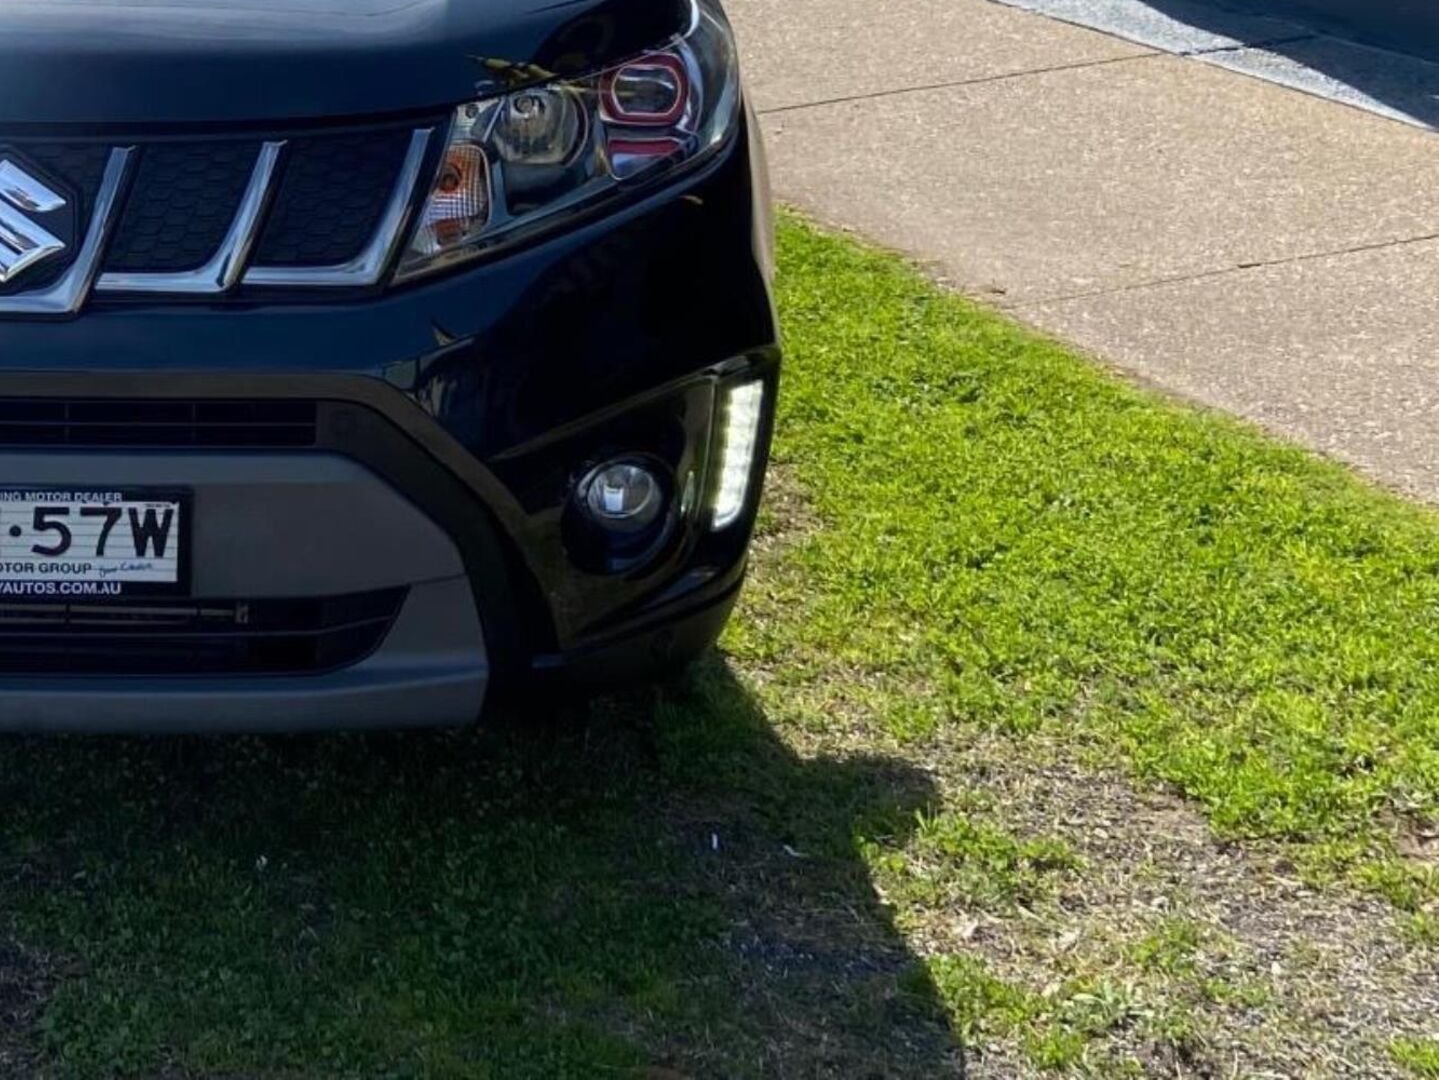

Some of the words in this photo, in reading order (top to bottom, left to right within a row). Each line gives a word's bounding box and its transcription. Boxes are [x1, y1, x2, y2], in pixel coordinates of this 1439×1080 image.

[24, 492, 72, 503] MOTOR
[74, 492, 123, 504] DEALER
[38, 562, 92, 574] GROUP
